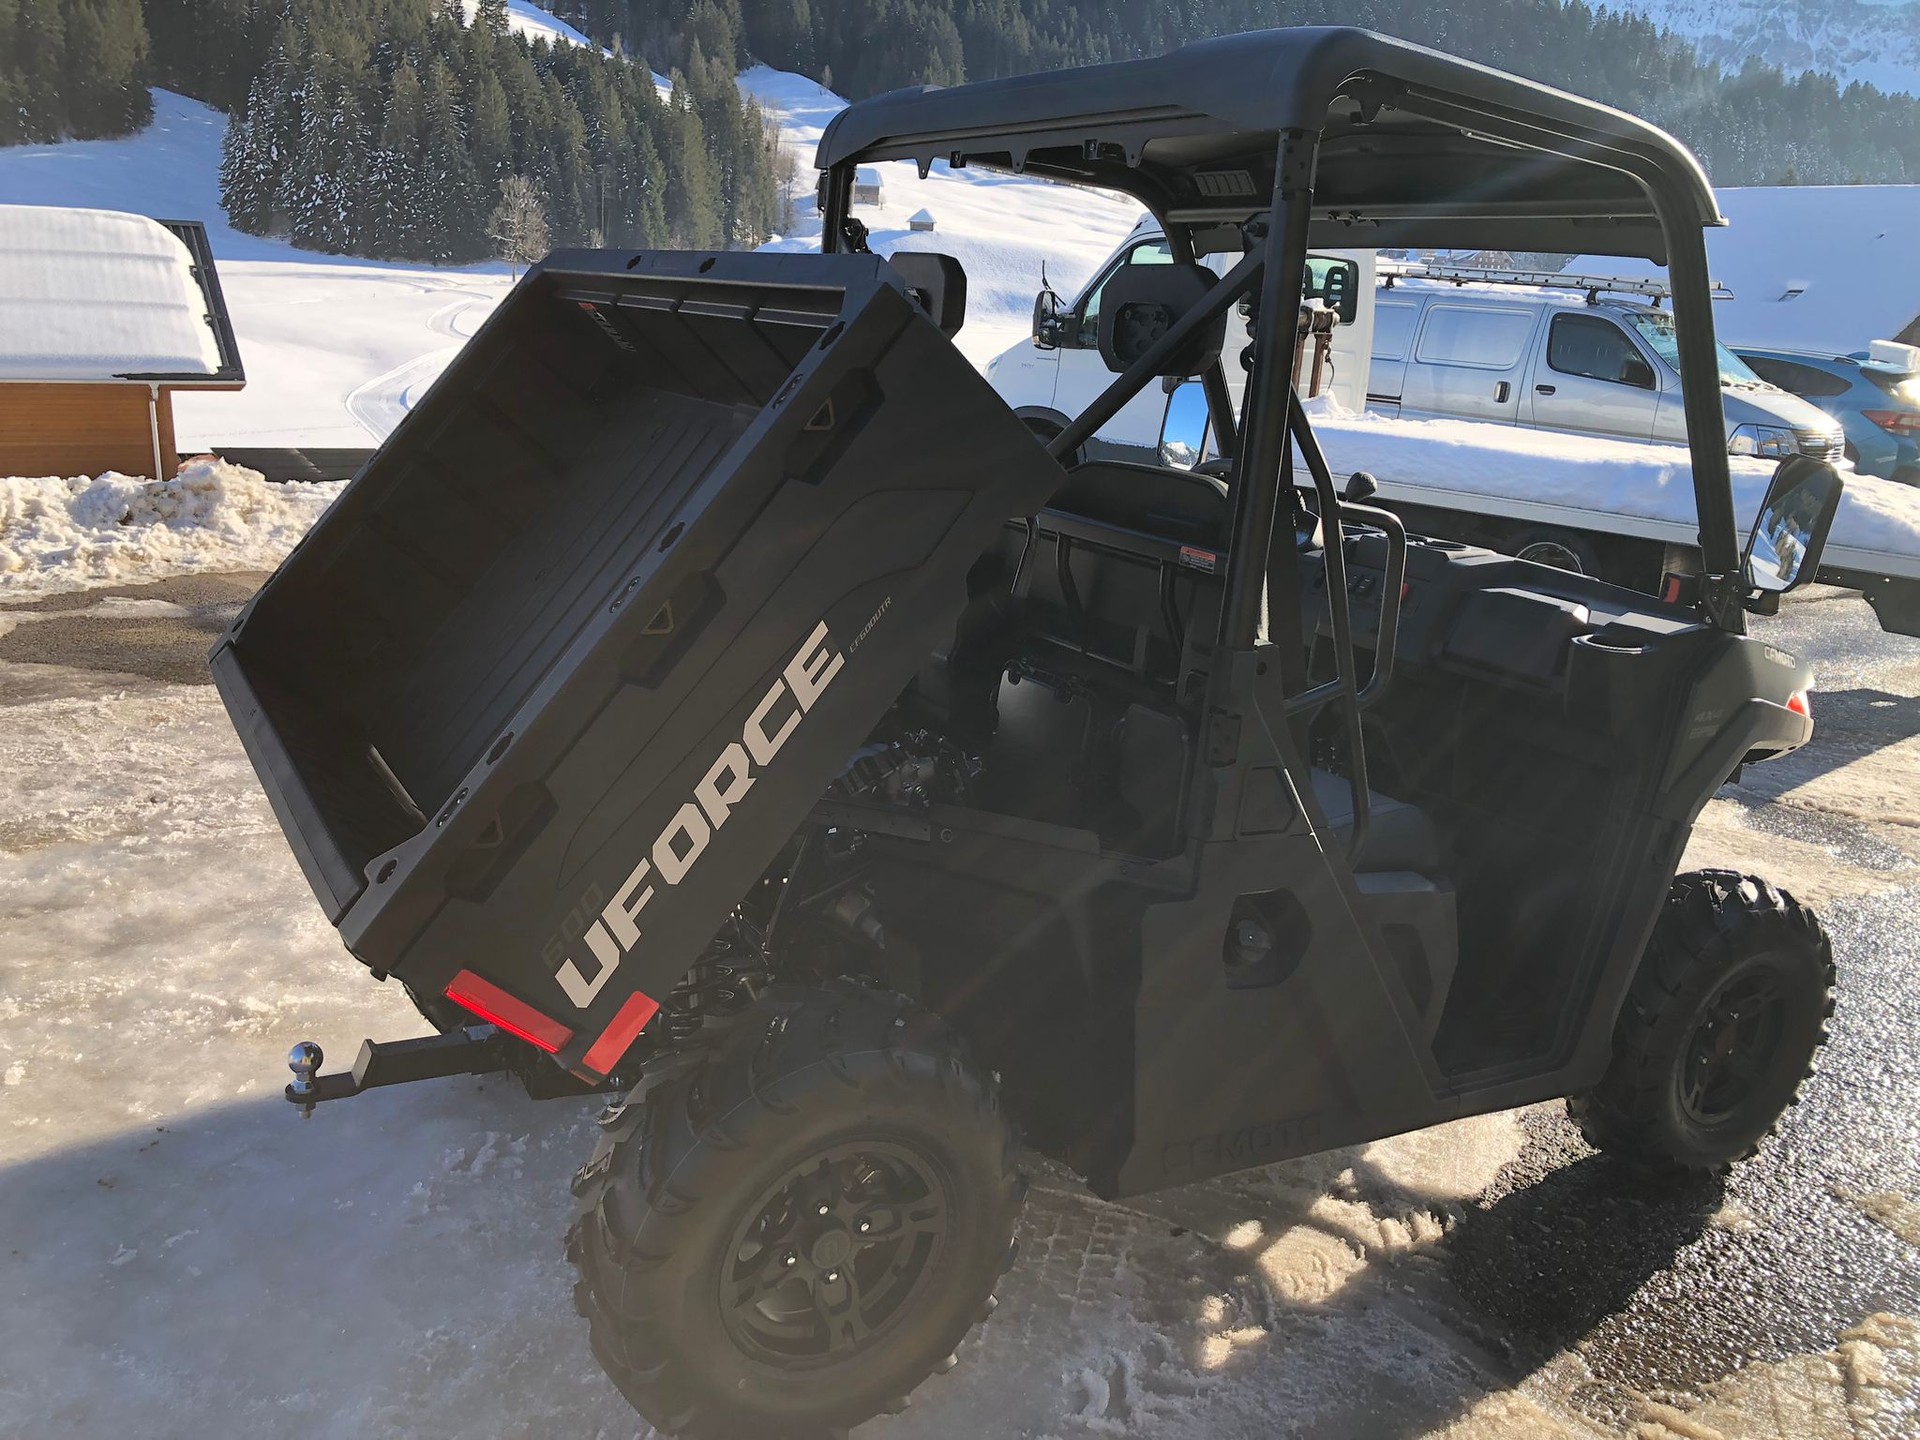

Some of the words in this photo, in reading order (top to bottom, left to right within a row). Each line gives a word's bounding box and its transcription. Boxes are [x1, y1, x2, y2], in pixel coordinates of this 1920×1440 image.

[849, 596, 891, 653] CF600UTR
[554, 620, 845, 1008] UFORCE
[541, 881, 604, 970] 600
